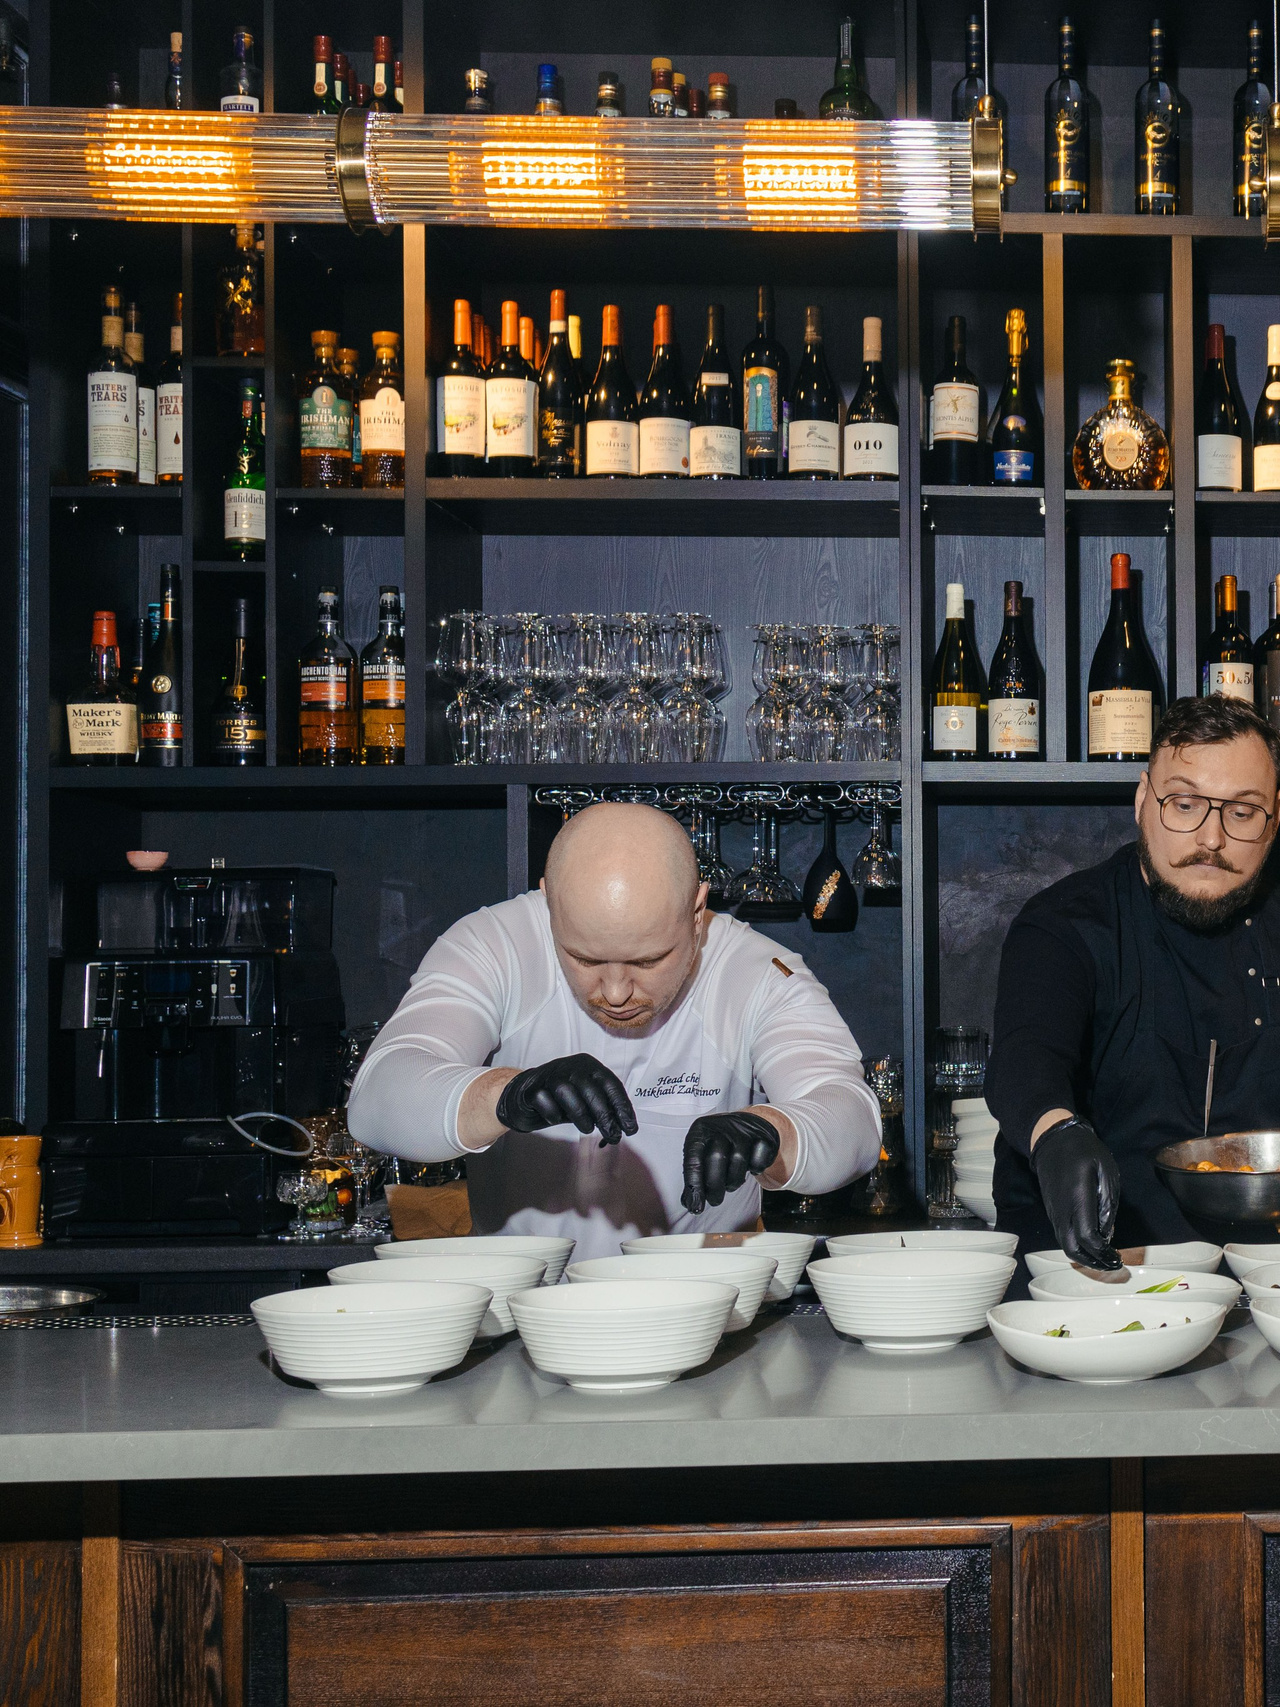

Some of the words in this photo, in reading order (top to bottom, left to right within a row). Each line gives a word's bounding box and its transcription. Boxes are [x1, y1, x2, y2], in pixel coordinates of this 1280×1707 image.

[91, 392, 127, 403] TEARS
[301, 414, 350, 425] IRISHMAN
[853, 439, 883, 450] 010
[226, 492, 265, 505] Glenfiddich
[301, 665, 347, 676] AUCHENTOSHAN
[363, 664, 405, 674] AUCHENTOSHA
[1216, 670, 1235, 685] 50
[72, 709, 122, 718] Maker's
[86, 719, 122, 728] Mark
[225, 726, 245, 739] 15
[656, 1072, 686, 1086] Head
[634, 1084, 678, 1098] Mikhail
